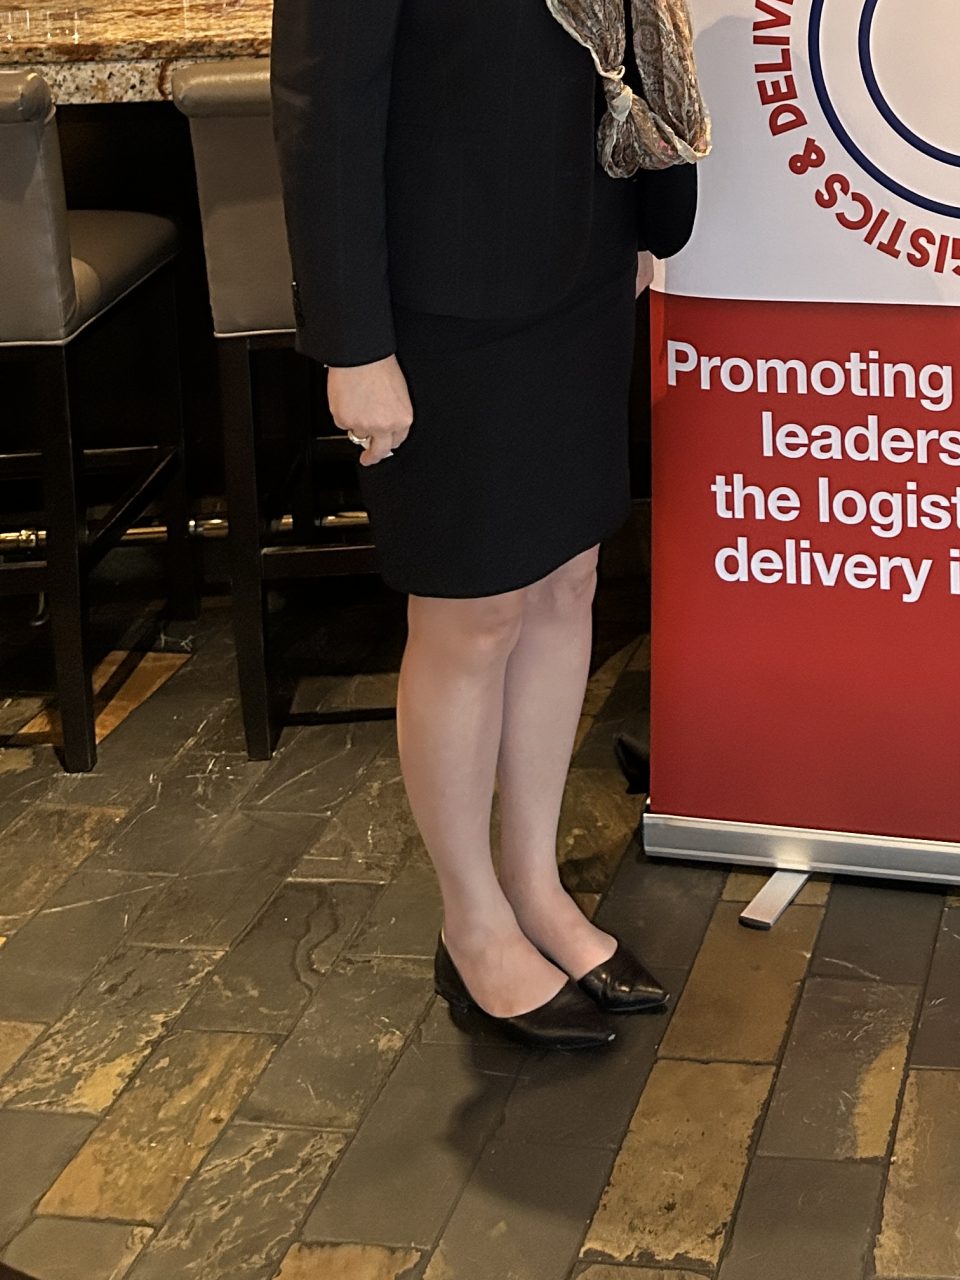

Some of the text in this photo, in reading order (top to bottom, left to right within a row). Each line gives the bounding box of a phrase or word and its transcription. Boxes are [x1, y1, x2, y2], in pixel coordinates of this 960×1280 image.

[789, 138, 826, 176] &
[666, 340, 953, 412] Promoting
[710, 473, 801, 522] the
[714, 537, 933, 603] delivery
